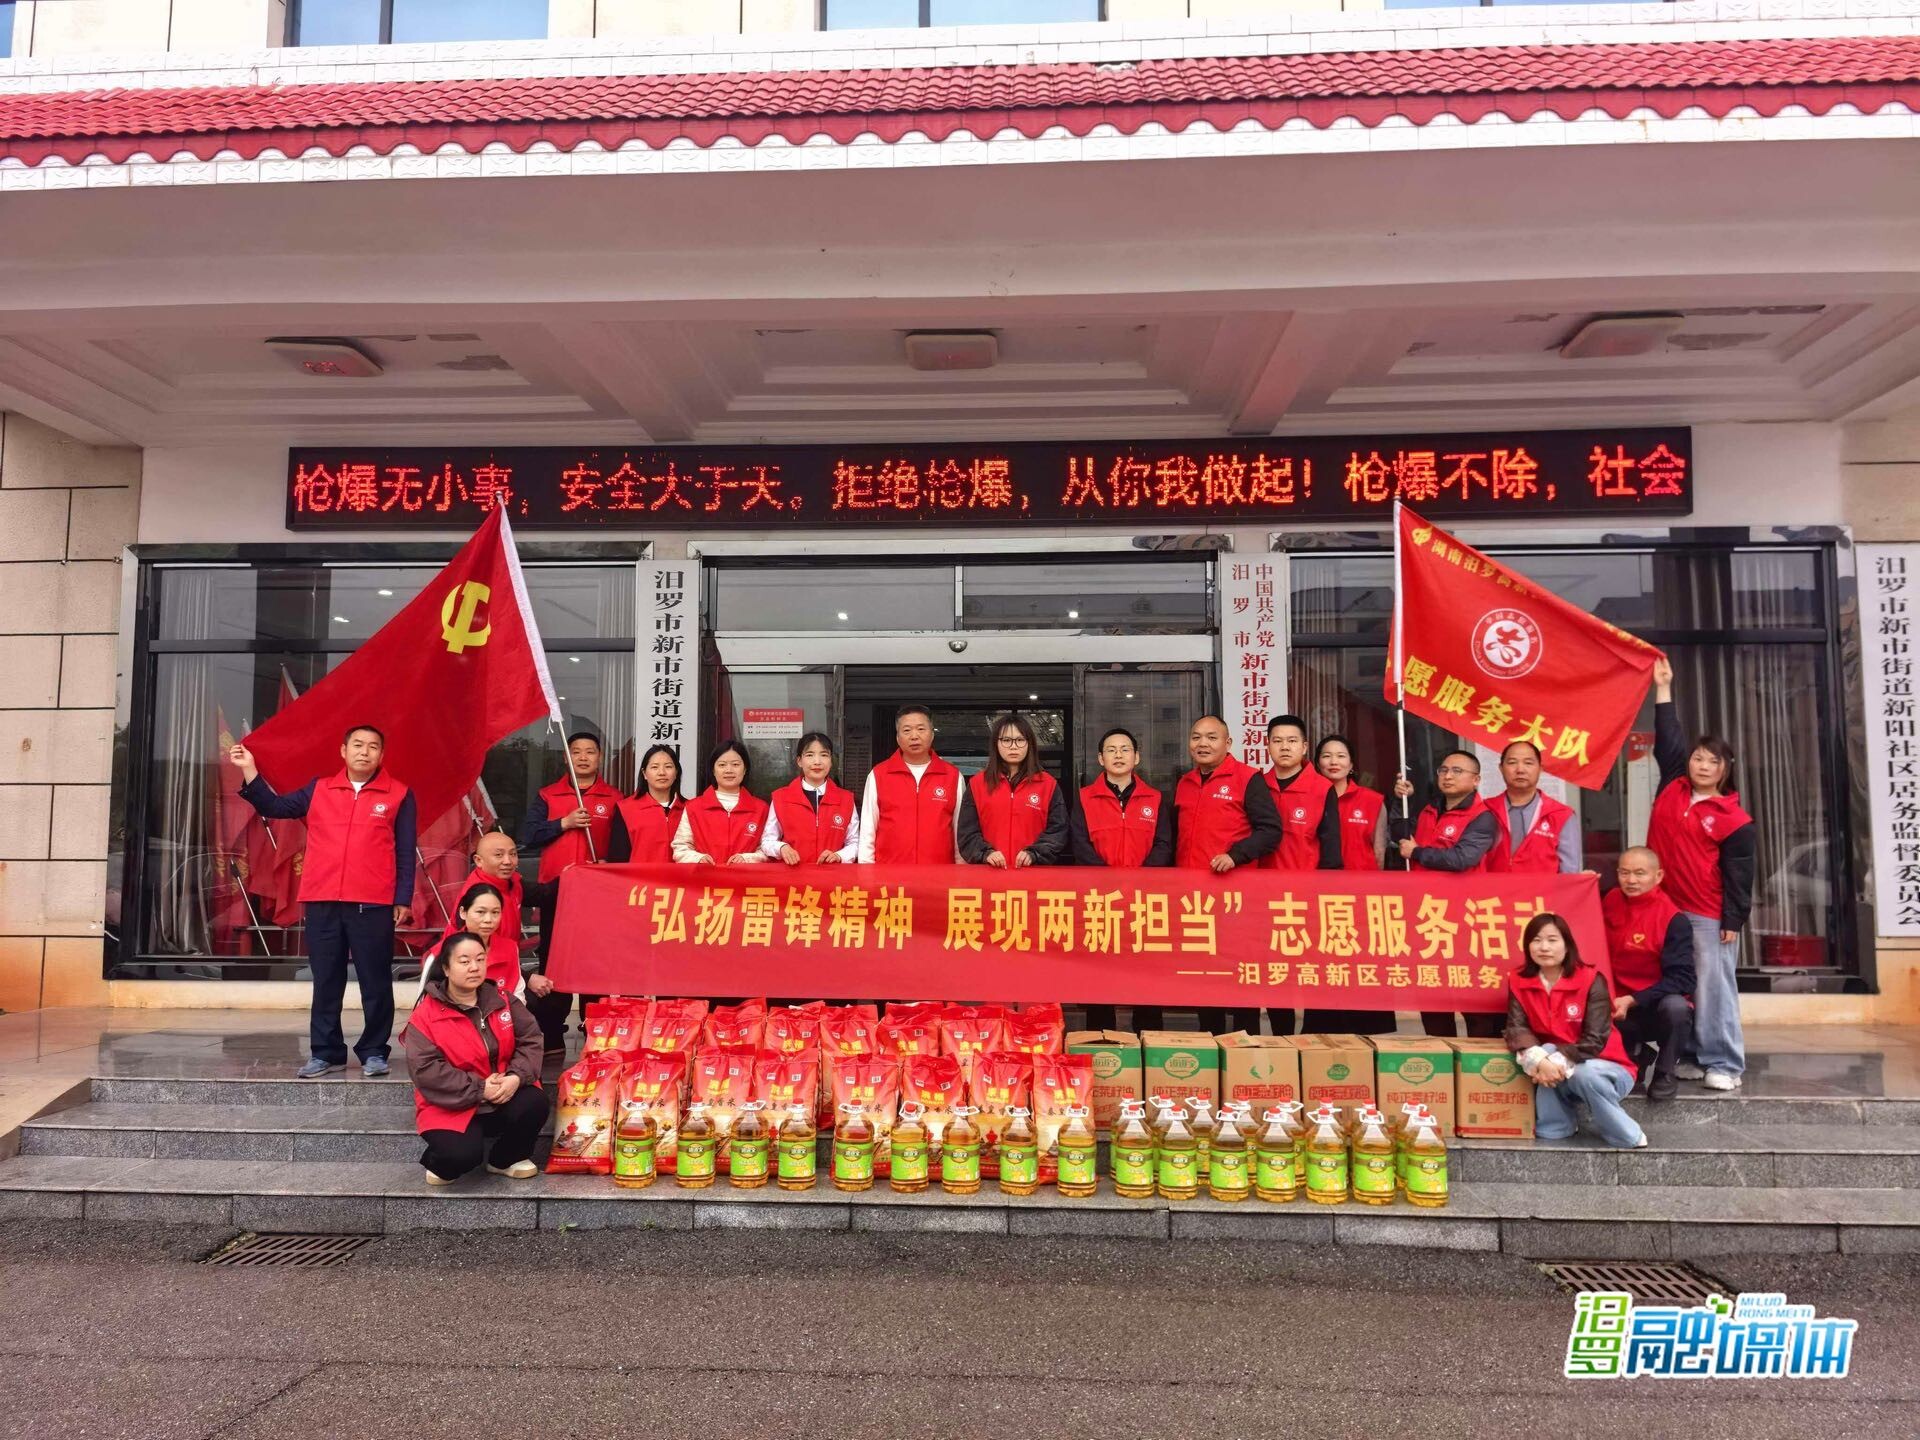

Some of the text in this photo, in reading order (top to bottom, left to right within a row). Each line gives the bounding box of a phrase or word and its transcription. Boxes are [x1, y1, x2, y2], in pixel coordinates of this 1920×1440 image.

[1232, 564, 1250, 648] 汨罗市
[1255, 563, 1275, 648] 中国共产党
[1240, 652, 1271, 774] 新市街道新阳
[1402, 655, 1591, 767] 愿服务大队
[628, 885, 914, 950] “弘扬雷锋精神
[943, 888, 1243, 956] 展现两新担当”
[1177, 962, 1510, 990] ——汨罗高新区志愿服务
